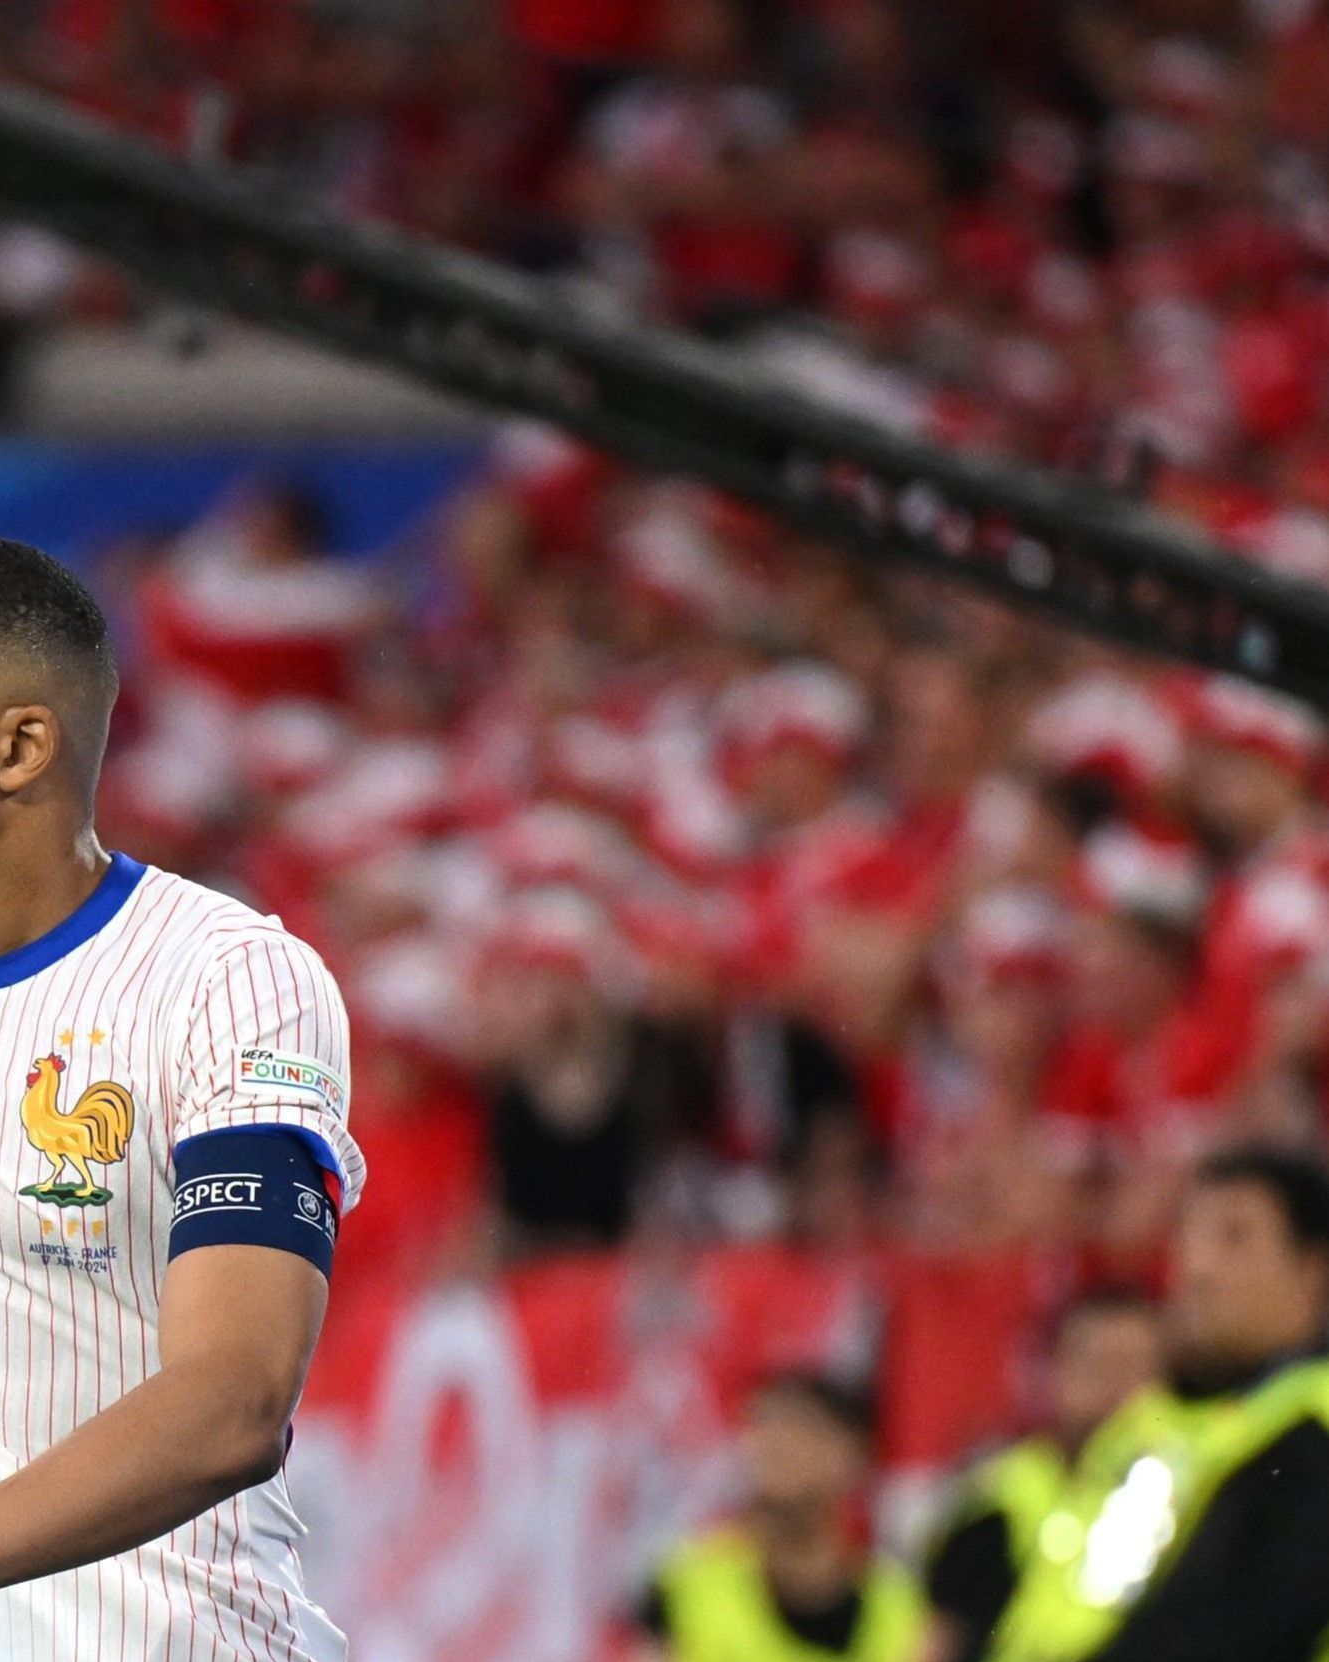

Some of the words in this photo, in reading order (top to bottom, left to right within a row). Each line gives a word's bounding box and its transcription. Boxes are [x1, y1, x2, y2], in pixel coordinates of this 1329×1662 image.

[241, 1049, 273, 1061] UEFA
[81, 1246, 117, 1260] FRANCE
[77, 1260, 108, 1273] 2024
